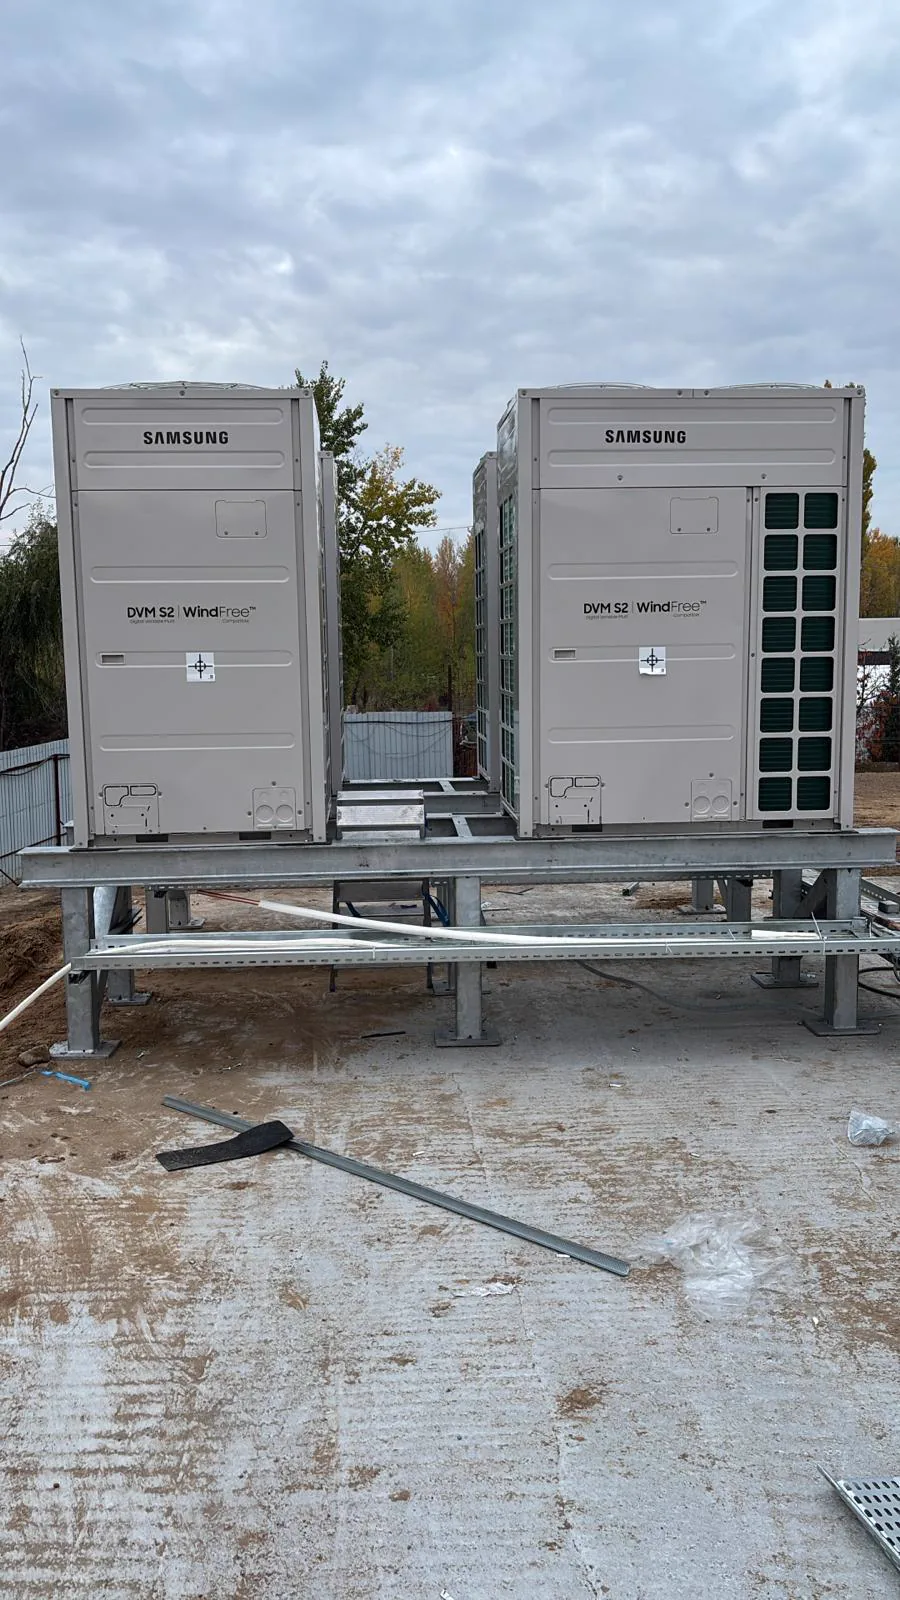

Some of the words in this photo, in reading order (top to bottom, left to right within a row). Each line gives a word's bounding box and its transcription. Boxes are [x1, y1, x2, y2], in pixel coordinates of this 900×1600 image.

[143, 431, 229, 445] SAMSUNG
[605, 430, 686, 444] SAMSUNG
[127, 606, 156, 618] DVM
[159, 606, 175, 618] S2
[583, 603, 611, 614] DVM
[614, 602, 629, 613] S2
